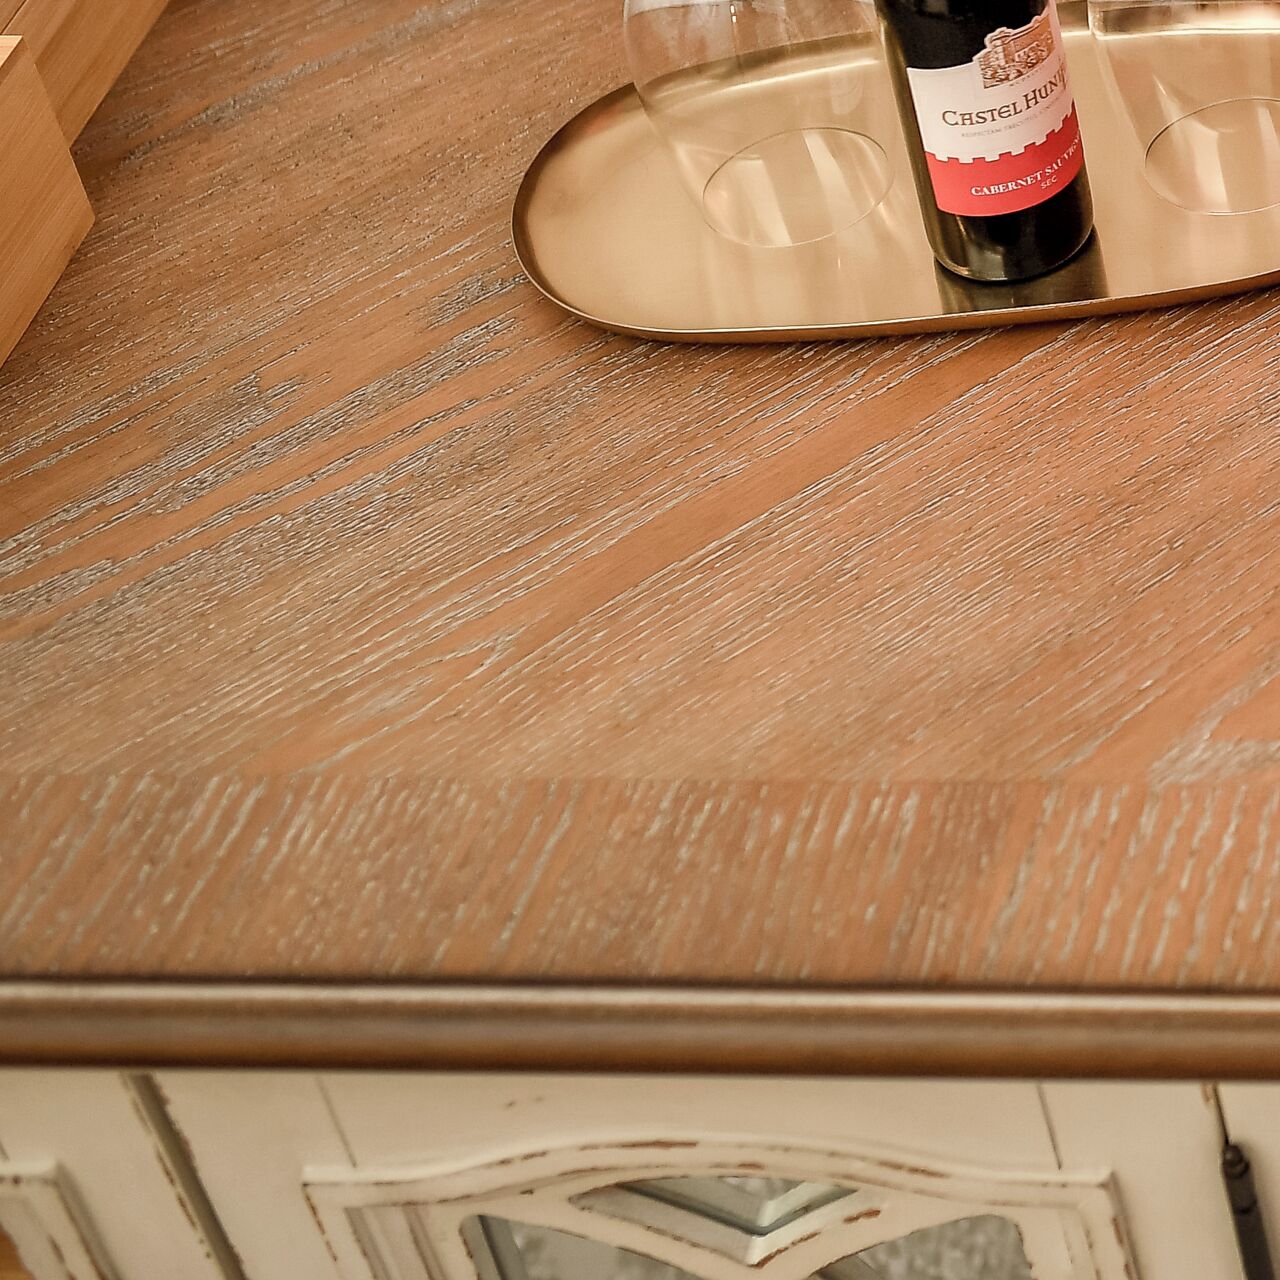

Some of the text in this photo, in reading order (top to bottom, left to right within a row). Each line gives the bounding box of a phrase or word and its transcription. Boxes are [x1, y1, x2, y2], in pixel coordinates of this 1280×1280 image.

[942, 102, 1023, 127] CASTEL
[971, 171, 1043, 196] CABERNET
[1041, 176, 1057, 189] SEC
